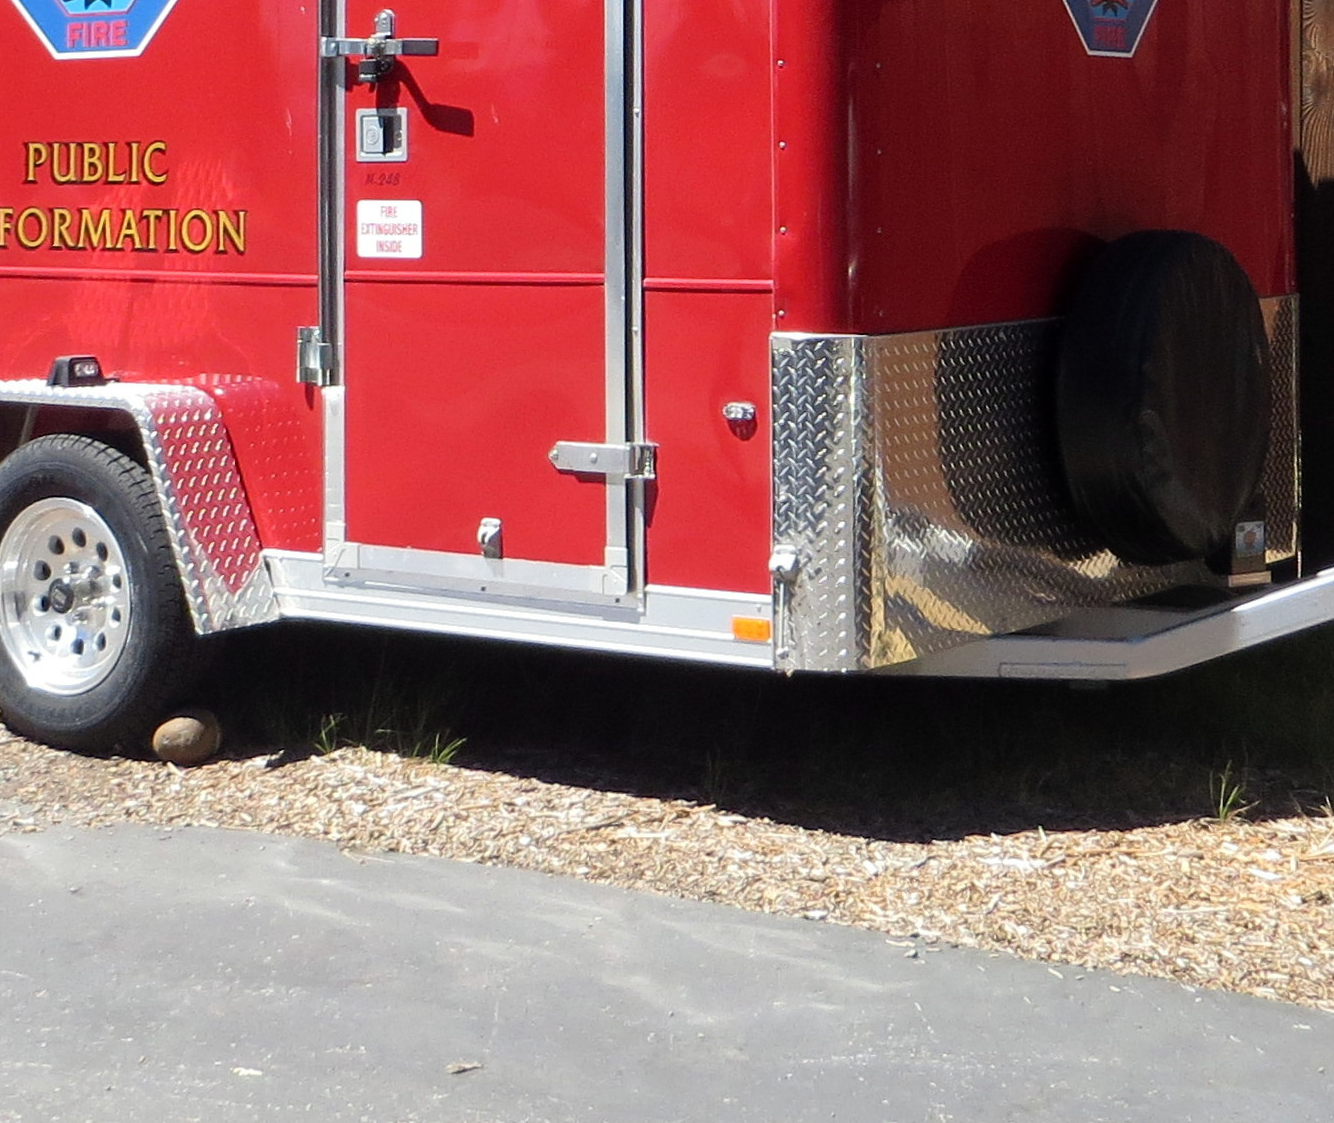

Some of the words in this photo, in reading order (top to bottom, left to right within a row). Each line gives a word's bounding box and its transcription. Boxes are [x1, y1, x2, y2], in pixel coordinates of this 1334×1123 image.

[66, 20, 129, 48] FIRE
[23, 140, 168, 185] PUBLIC
[380, 206, 398, 218] FIRE
[361, 223, 419, 236] EXTINGUISHER
[376, 240, 402, 253] INSIDE
